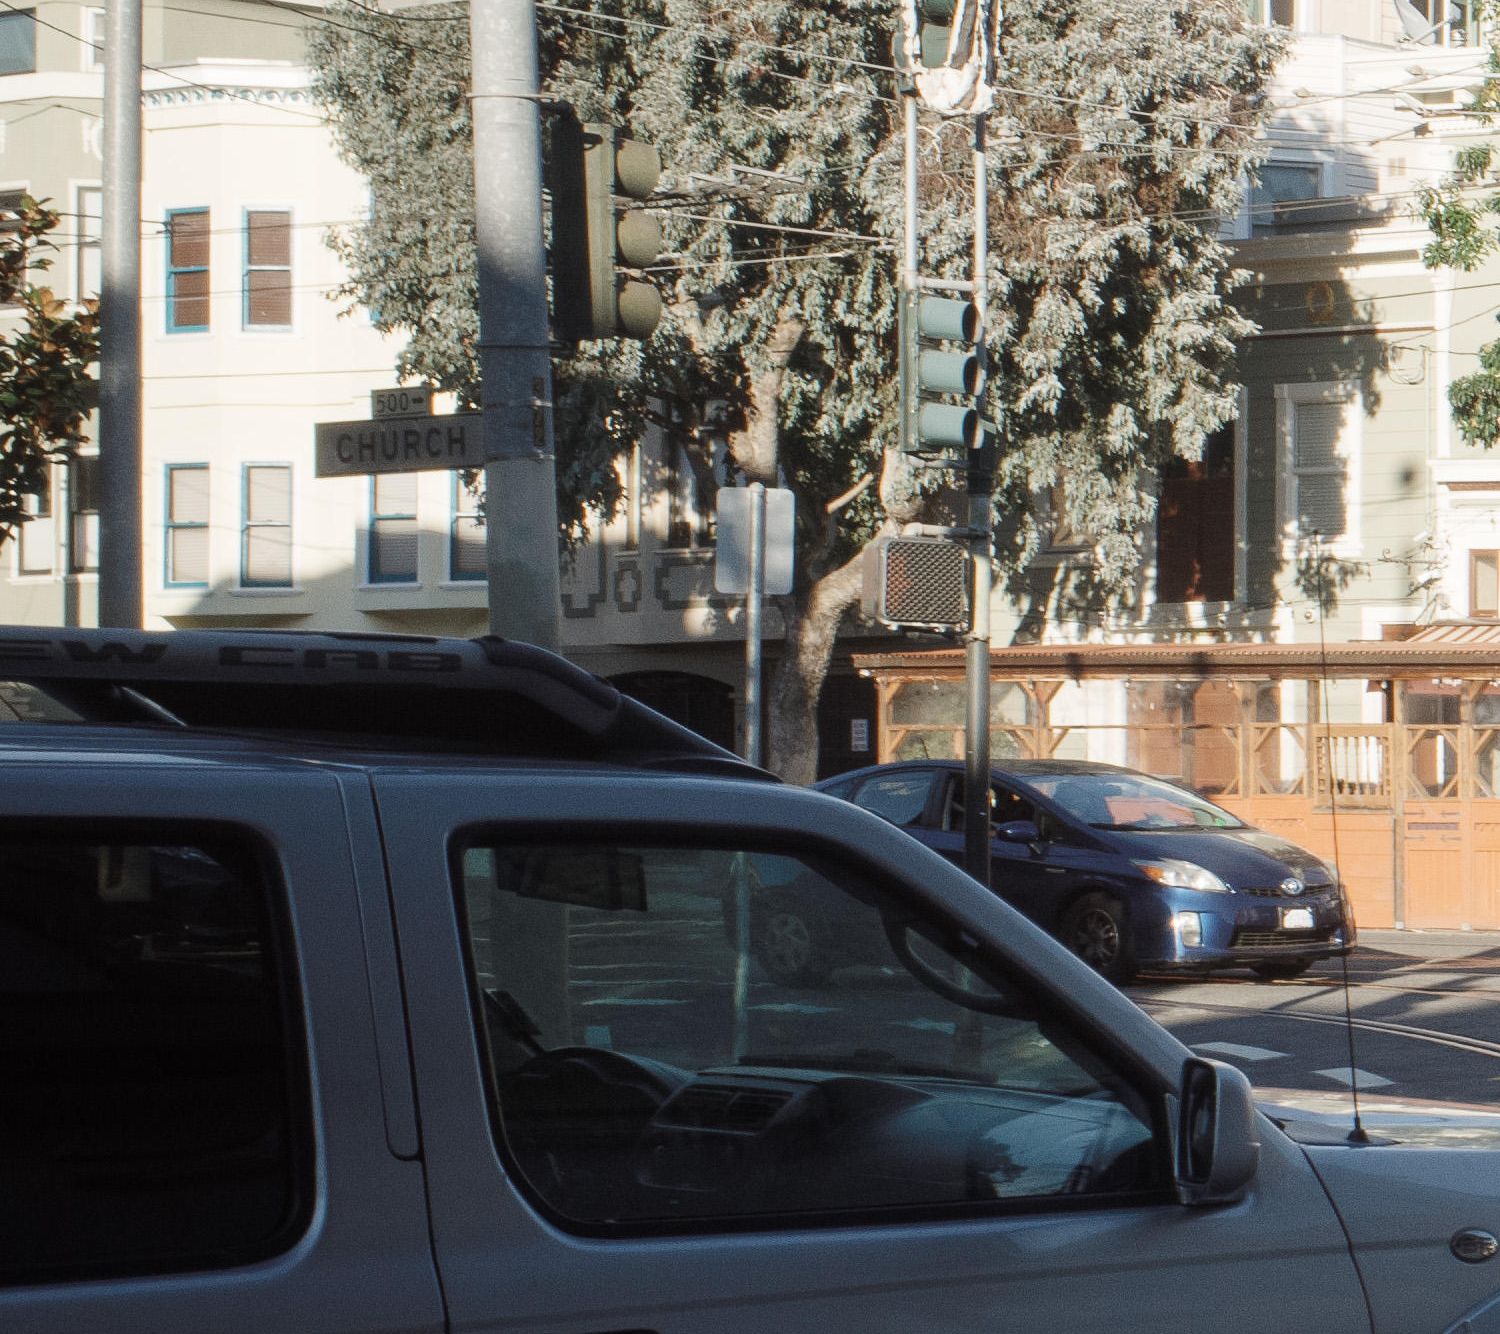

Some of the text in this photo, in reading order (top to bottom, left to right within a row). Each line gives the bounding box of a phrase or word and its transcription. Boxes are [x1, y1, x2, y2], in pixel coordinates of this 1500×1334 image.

[375, 392, 409, 414] 500
[336, 426, 466, 464] CHURCH
[218, 644, 463, 672] CAB
